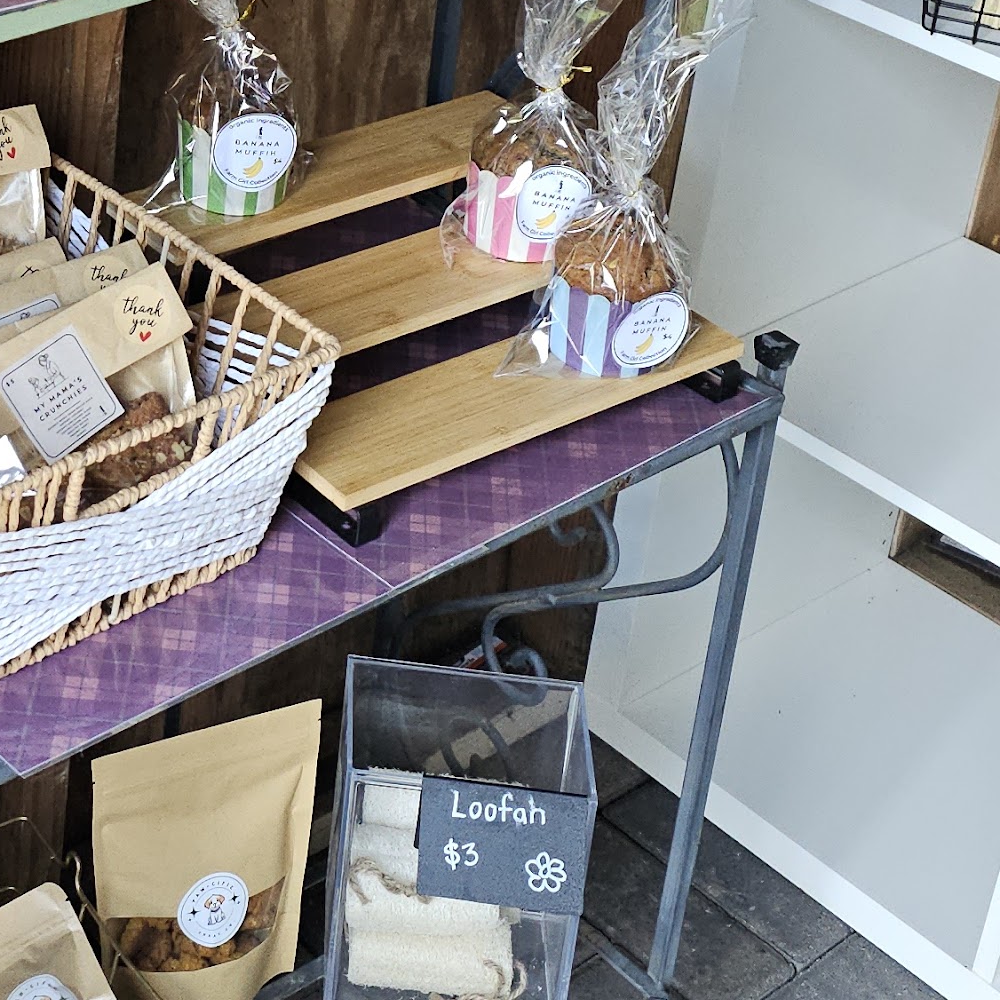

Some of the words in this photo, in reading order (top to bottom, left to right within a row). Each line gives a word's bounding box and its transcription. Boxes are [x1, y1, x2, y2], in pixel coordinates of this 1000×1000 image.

[235, 139, 280, 147] BANANA
[532, 200, 571, 210] MUFFIN
[534, 191, 576, 202] BANANA
[122, 297, 165, 318] thank
[129, 316, 157, 335] you
[632, 326, 667, 334] MUFFIN
[634, 317, 671, 326] BANANA
[34, 402, 46, 413] MY
[48, 376, 82, 402] MAMA'S
[39, 385, 88, 421] CRUNCHIES
[451, 788, 546, 825] Loofah
[443, 837, 479, 871] $3
